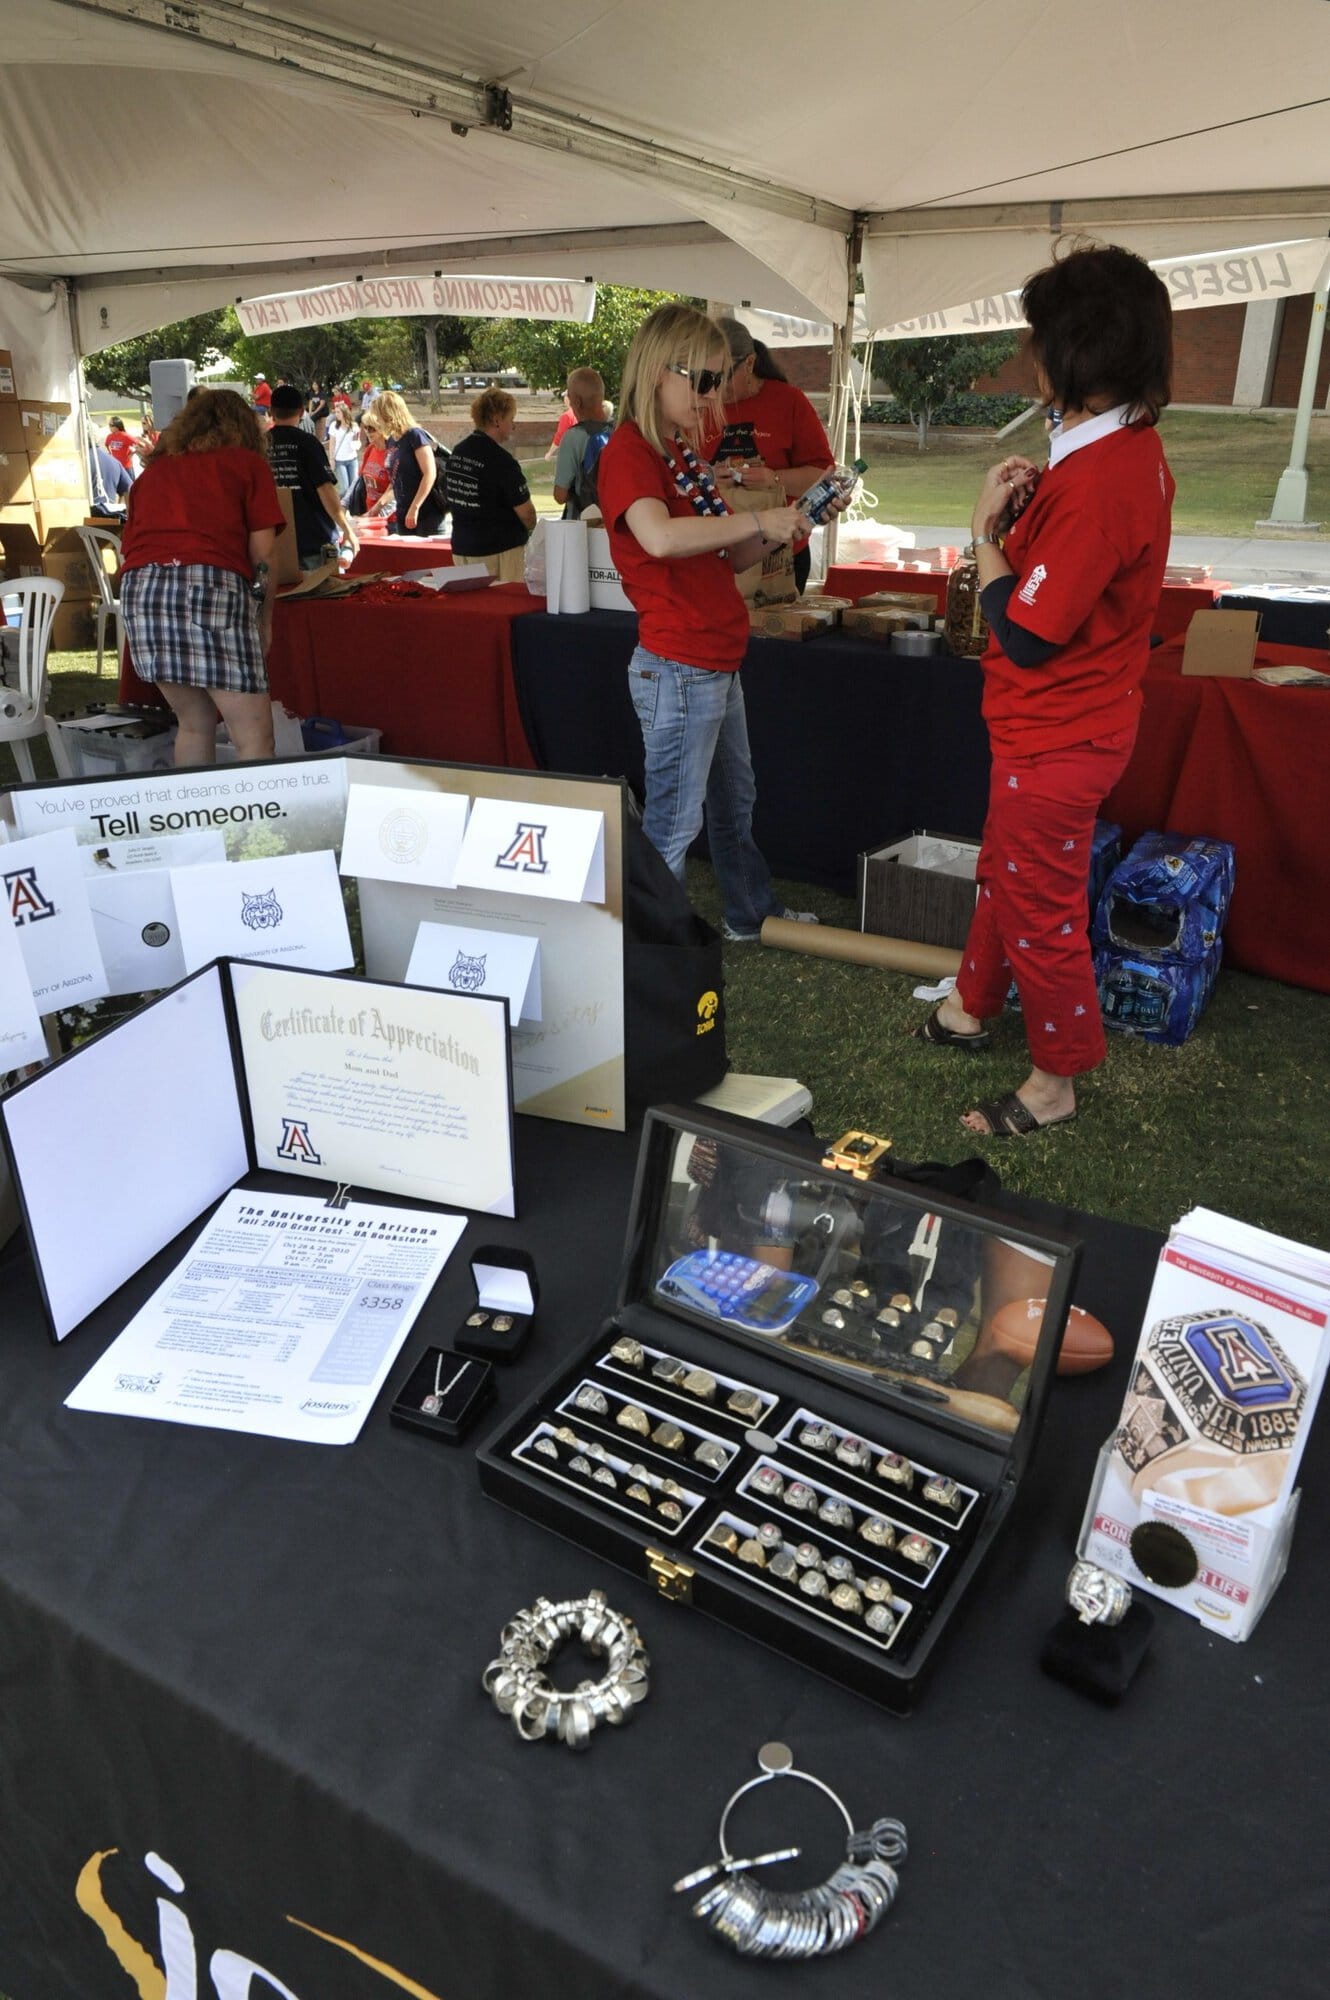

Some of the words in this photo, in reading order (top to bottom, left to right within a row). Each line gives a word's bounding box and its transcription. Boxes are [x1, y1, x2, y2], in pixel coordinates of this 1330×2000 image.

[35, 798, 85, 815] You've
[90, 792, 140, 811] proved
[145, 788, 172, 803] that
[178, 783, 230, 799] dreams
[234, 779, 253, 793] do
[258, 776, 298, 791] come
[302, 772, 330, 786] true.
[90, 811, 140, 838] Tell
[150, 800, 287, 832] someone.
[260, 1005, 345, 1042] Certificate
[349, 1010, 367, 1036] of
[370, 1007, 481, 1077] Appreciation
[344, 1062, 363, 1072] Mom
[366, 1067, 380, 1076] and
[383, 1069, 399, 1079] Dad
[238, 1207, 264, 1217] The
[271, 1209, 352, 1227] University
[358, 1220, 375, 1229] of
[378, 1222, 439, 1236] Arizona
[238, 1216, 259, 1226] Fall
[260, 1218, 288, 1229] 2010
[290, 1222, 318, 1232] Grad
[319, 1225, 344, 1236] Fest
[353, 1229, 368, 1238] UA
[370, 1231, 430, 1244] Bookstore
[367, 1280, 389, 1289] Class
[392, 1281, 415, 1291] Rings
[1175, 1257, 1188, 1269] THE
[1188, 1263, 1225, 1283] UNIVERSITY
[1225, 1278, 1235, 1287] OF
[1236, 1282, 1264, 1300] ARIZONA
[360, 1296, 404, 1310] $358
[301, 1398, 351, 1411] jostens
[1250, 1410, 1298, 1437] 1885
[1210, 1574, 1242, 1598] LIFE
